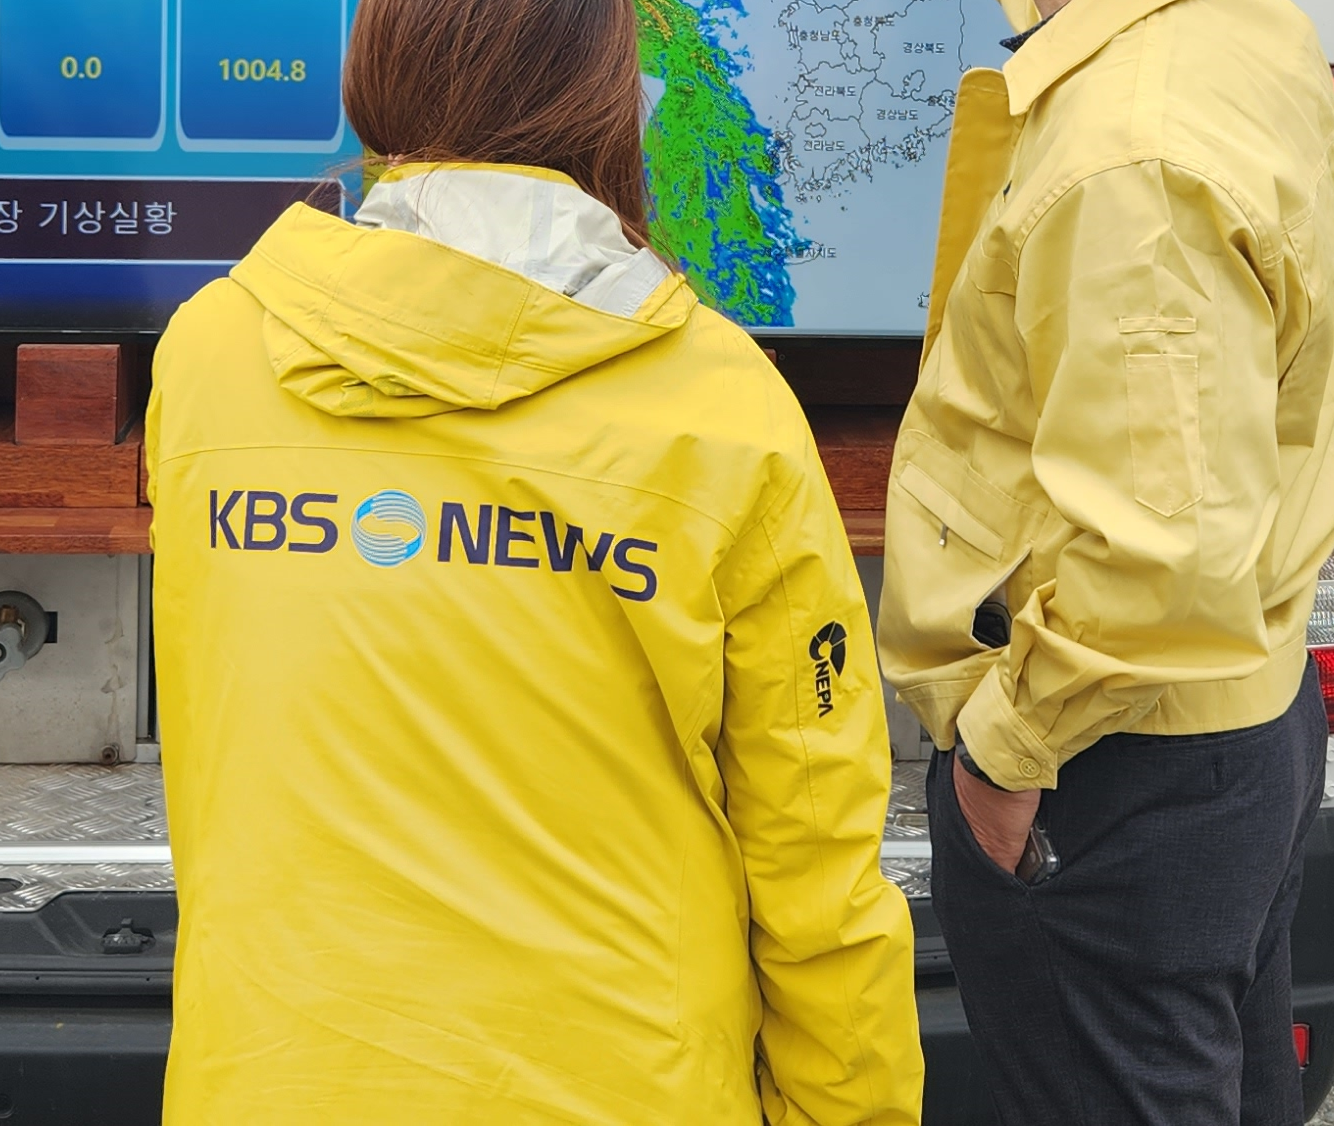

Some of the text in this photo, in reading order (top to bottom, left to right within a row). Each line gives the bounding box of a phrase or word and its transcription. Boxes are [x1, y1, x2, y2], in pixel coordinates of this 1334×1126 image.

[853, 16, 895, 27] 충청북도
[799, 30, 841, 42] 충청남도
[903, 42, 945, 54] 경상북도
[60, 55, 103, 79] 0.0
[218, 58, 307, 82] 1004.8
[814, 85, 856, 97] 전라북도
[876, 109, 918, 121] 경상남도
[803, 140, 846, 152] 전라남도
[38, 200, 178, 235] 기상실황
[209, 489, 659, 603] KBS NEWS
[813, 659, 835, 719] NEPA
